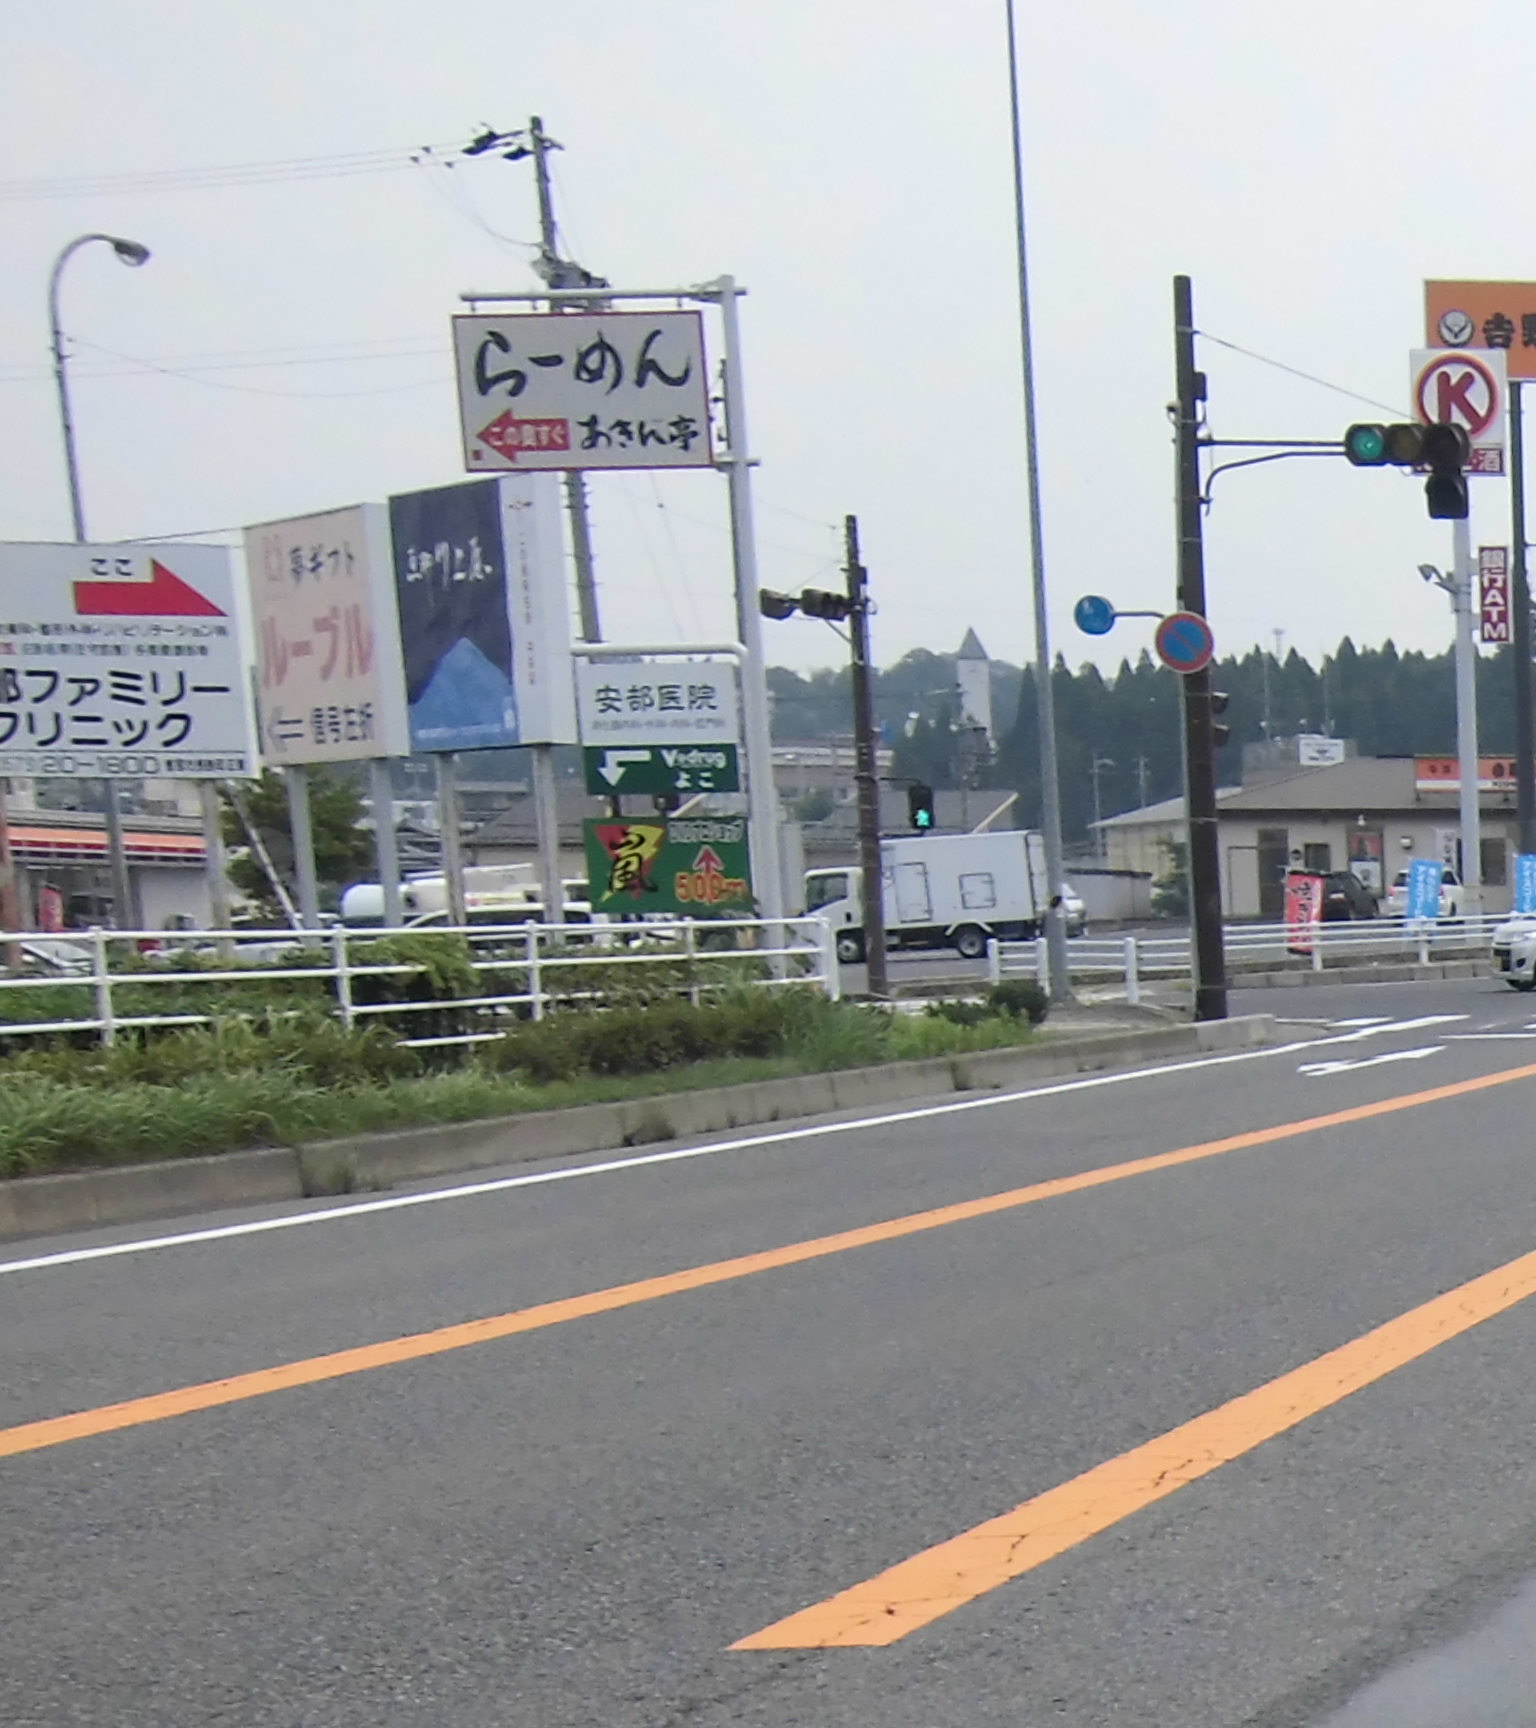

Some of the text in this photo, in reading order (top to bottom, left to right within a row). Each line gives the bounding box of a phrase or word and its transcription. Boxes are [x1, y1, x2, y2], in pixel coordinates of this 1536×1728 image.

[475, 328, 692, 397] らーめん
[90, 558, 133, 576] ここ
[595, 683, 718, 714] 安部医院
